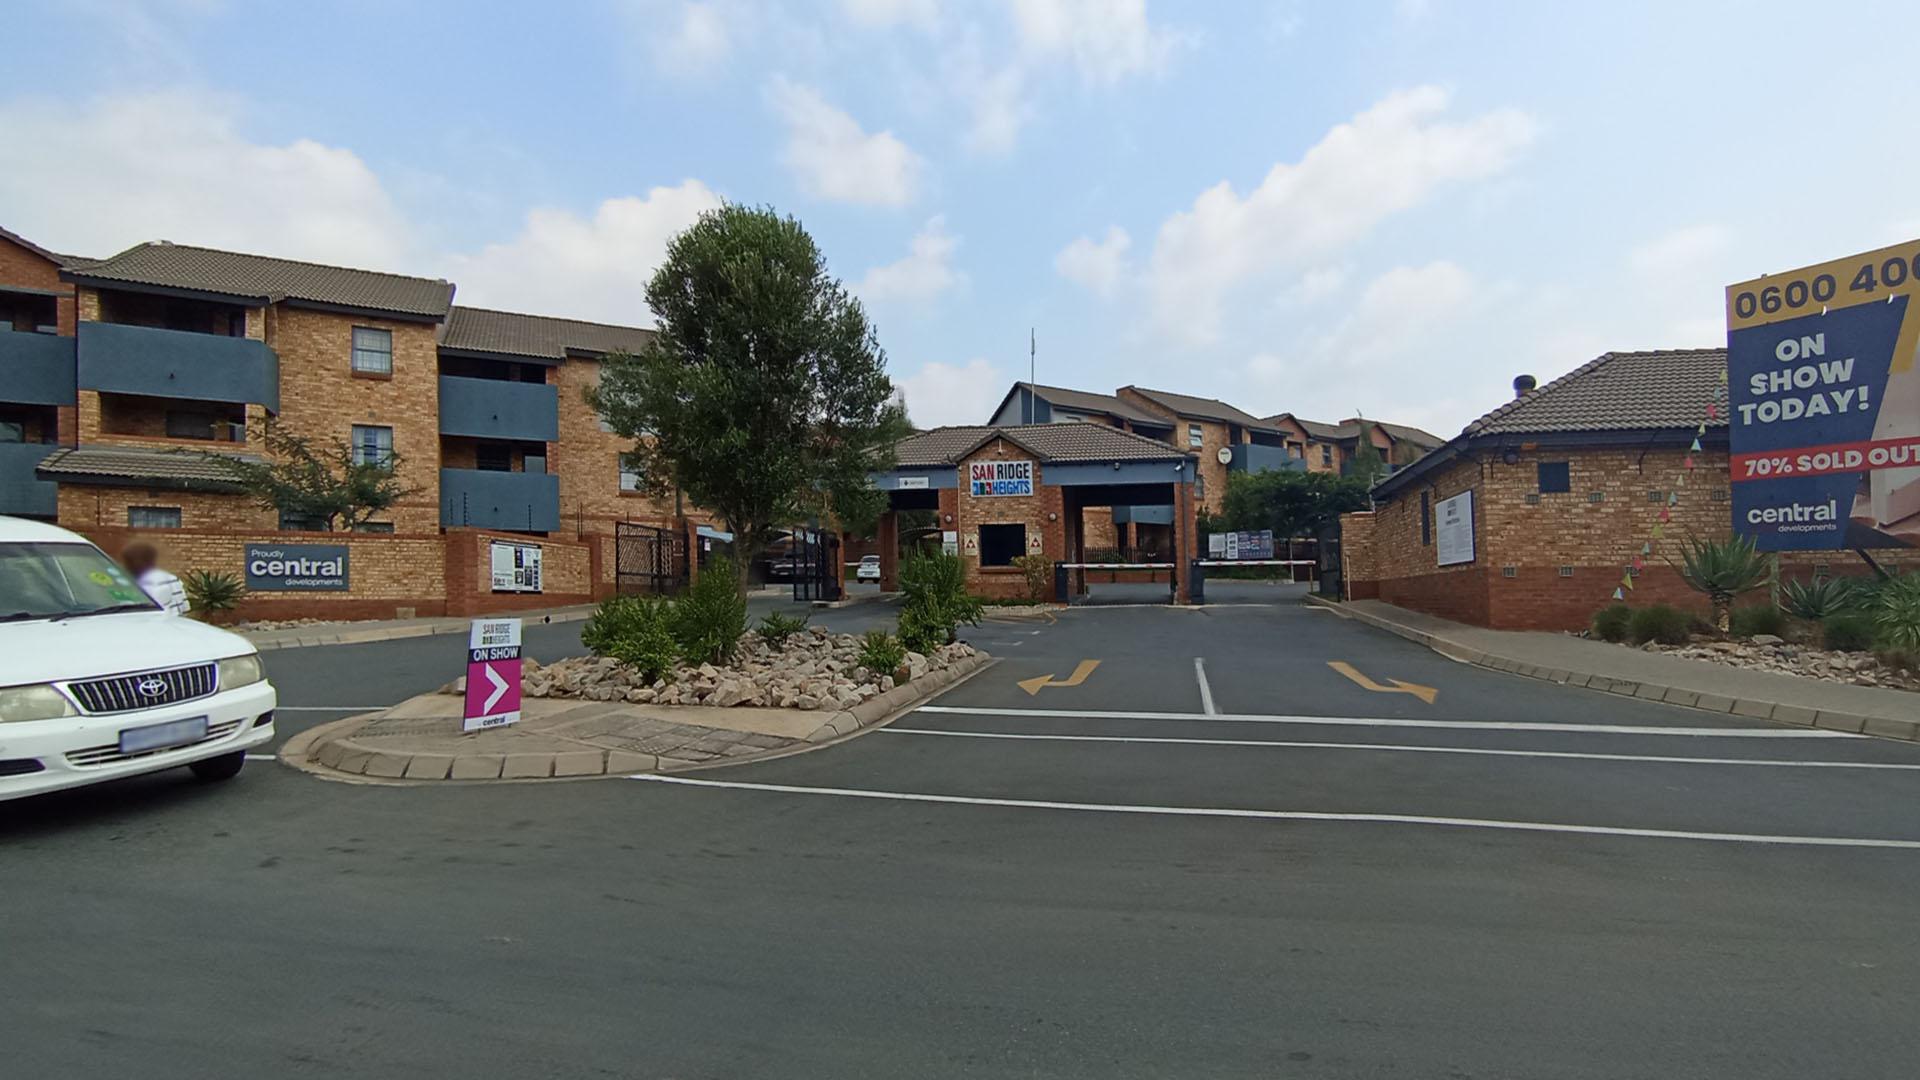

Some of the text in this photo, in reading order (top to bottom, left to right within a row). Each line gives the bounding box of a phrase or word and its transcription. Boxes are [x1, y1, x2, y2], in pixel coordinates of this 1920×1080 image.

[1735, 273, 1837, 319] 0600
[1775, 333, 1825, 362] ON
[1750, 358, 1855, 395] SHOW
[1738, 385, 1869, 425] TODAY!
[972, 463, 1029, 480] SAN RIDGE
[1744, 457, 1793, 477] 70%
[1797, 450, 1863, 472] SOLD
[992, 480, 1030, 495] HEIGHTS
[1747, 500, 1837, 524] central
[1778, 523, 1837, 533] developments
[251, 549, 284, 558] Proudly
[250, 557, 343, 576] central
[473, 648, 518, 661] ON SHOW
[482, 716, 506, 726] central
